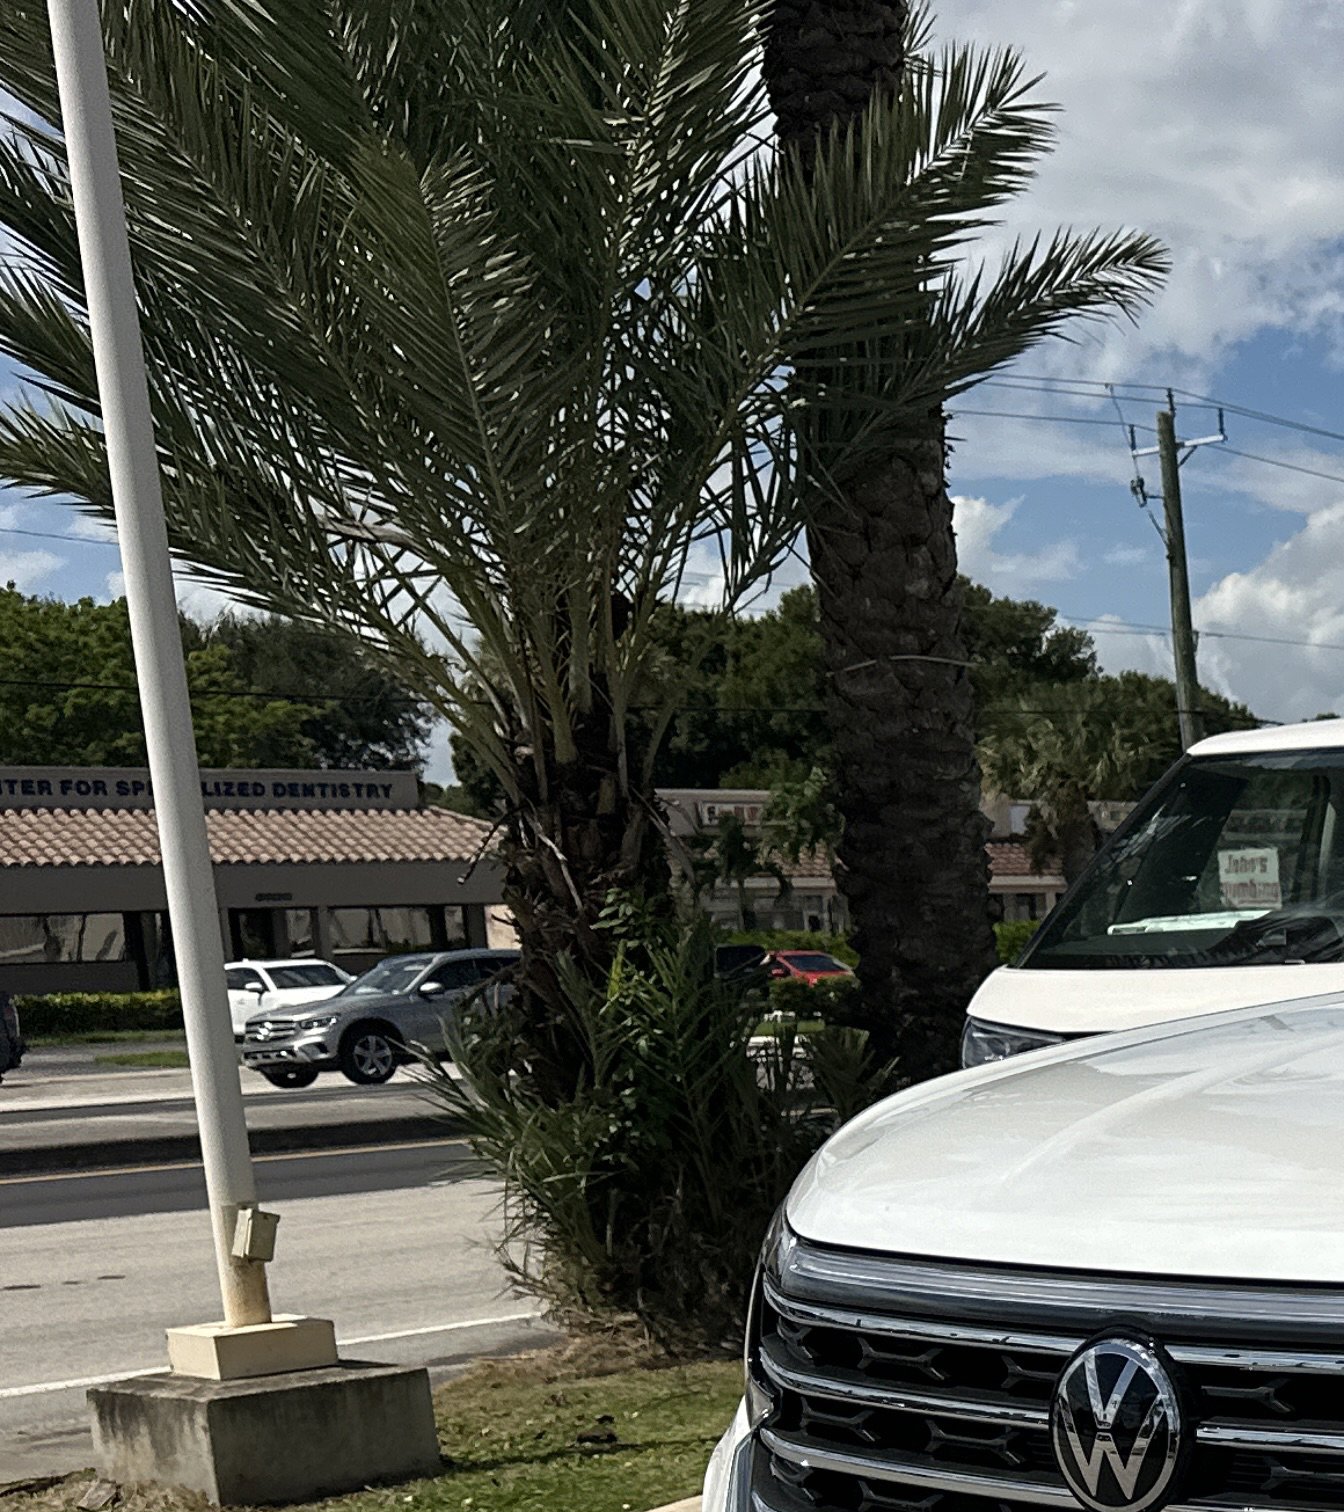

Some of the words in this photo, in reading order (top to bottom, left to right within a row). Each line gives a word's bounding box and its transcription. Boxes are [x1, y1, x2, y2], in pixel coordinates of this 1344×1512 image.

[0, 779, 53, 796] TER
[59, 780, 109, 796] FOR
[116, 781, 265, 797] SPLIZED
[272, 783, 393, 799] DENTISTRY
